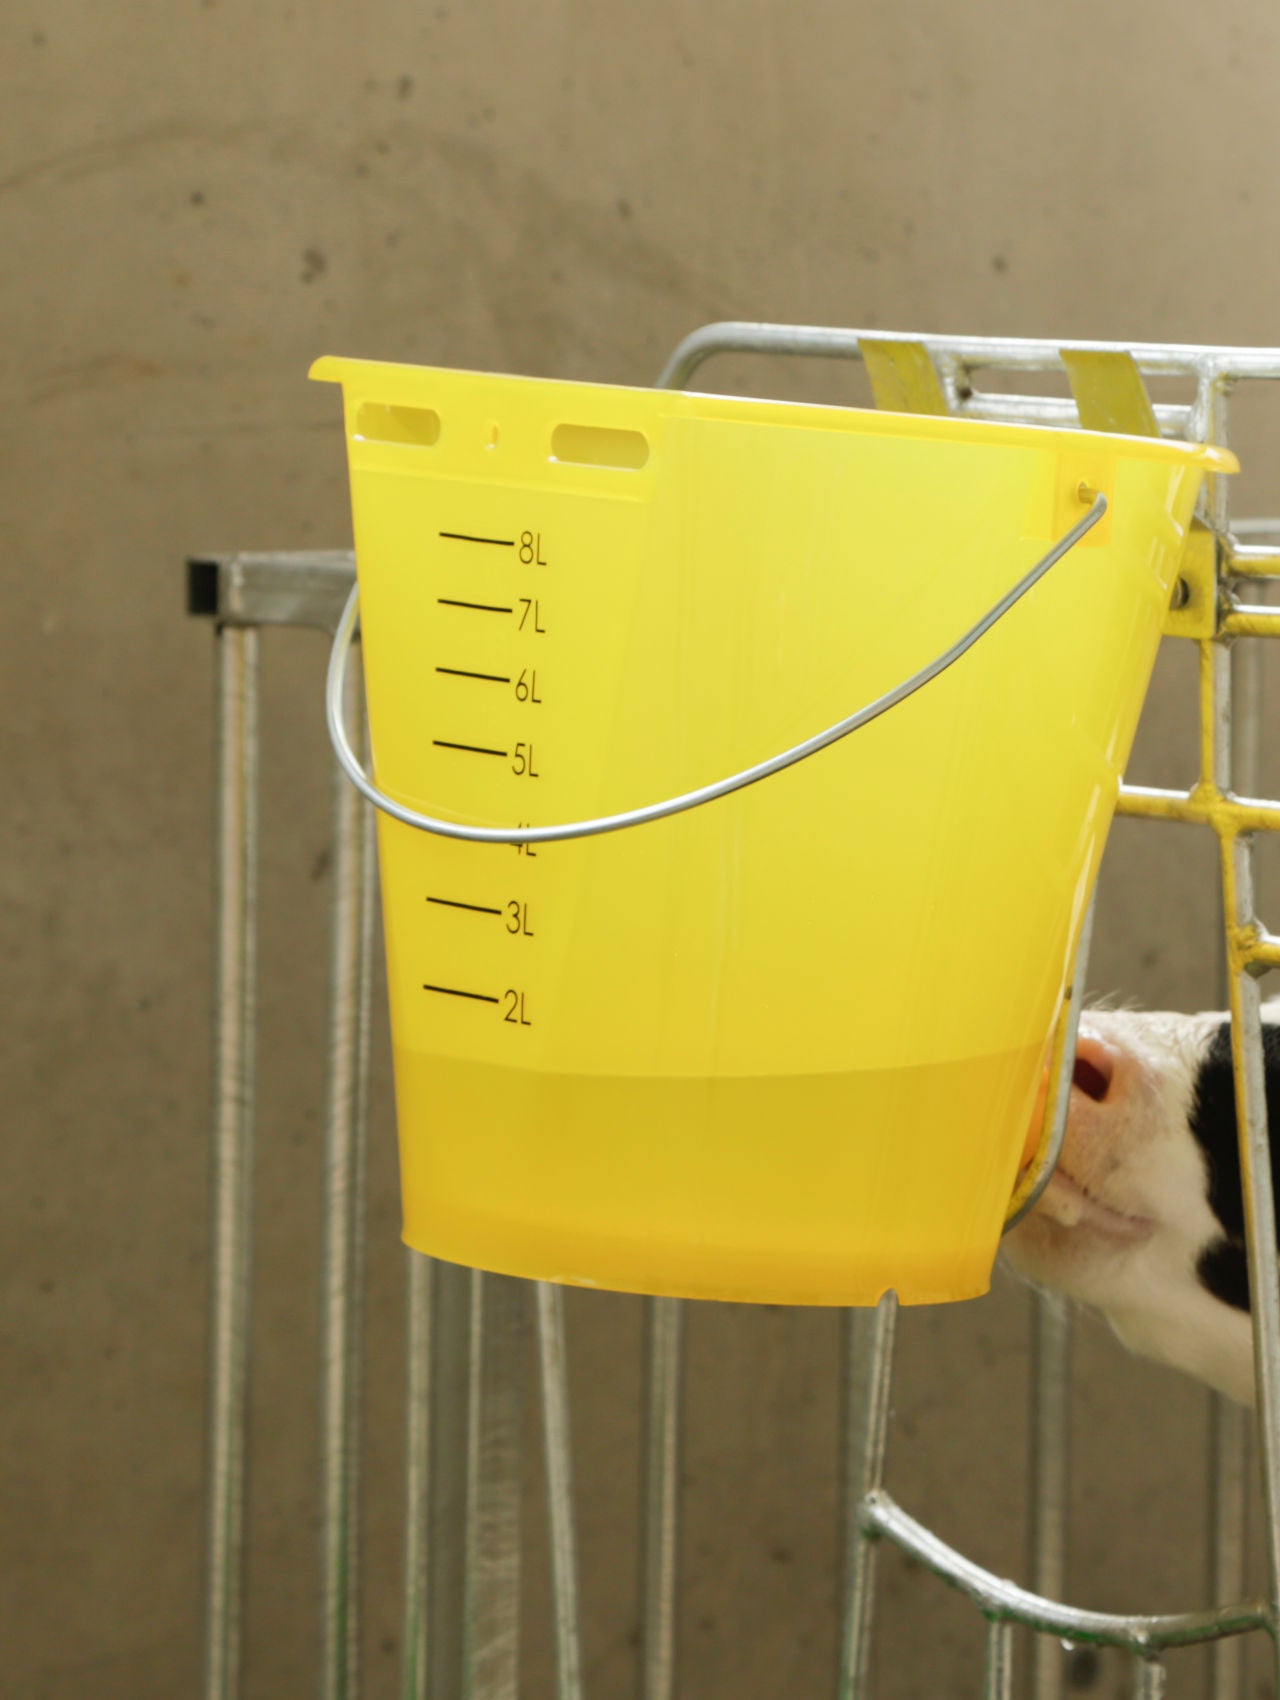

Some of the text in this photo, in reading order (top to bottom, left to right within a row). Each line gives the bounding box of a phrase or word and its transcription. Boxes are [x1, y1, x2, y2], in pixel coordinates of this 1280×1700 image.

[519, 531, 547, 566] 8L
[518, 598, 546, 633] 7L
[515, 669, 542, 704] 6L
[512, 742, 539, 778] 5L
[506, 900, 534, 936] 3L
[504, 989, 531, 1026] 2L
